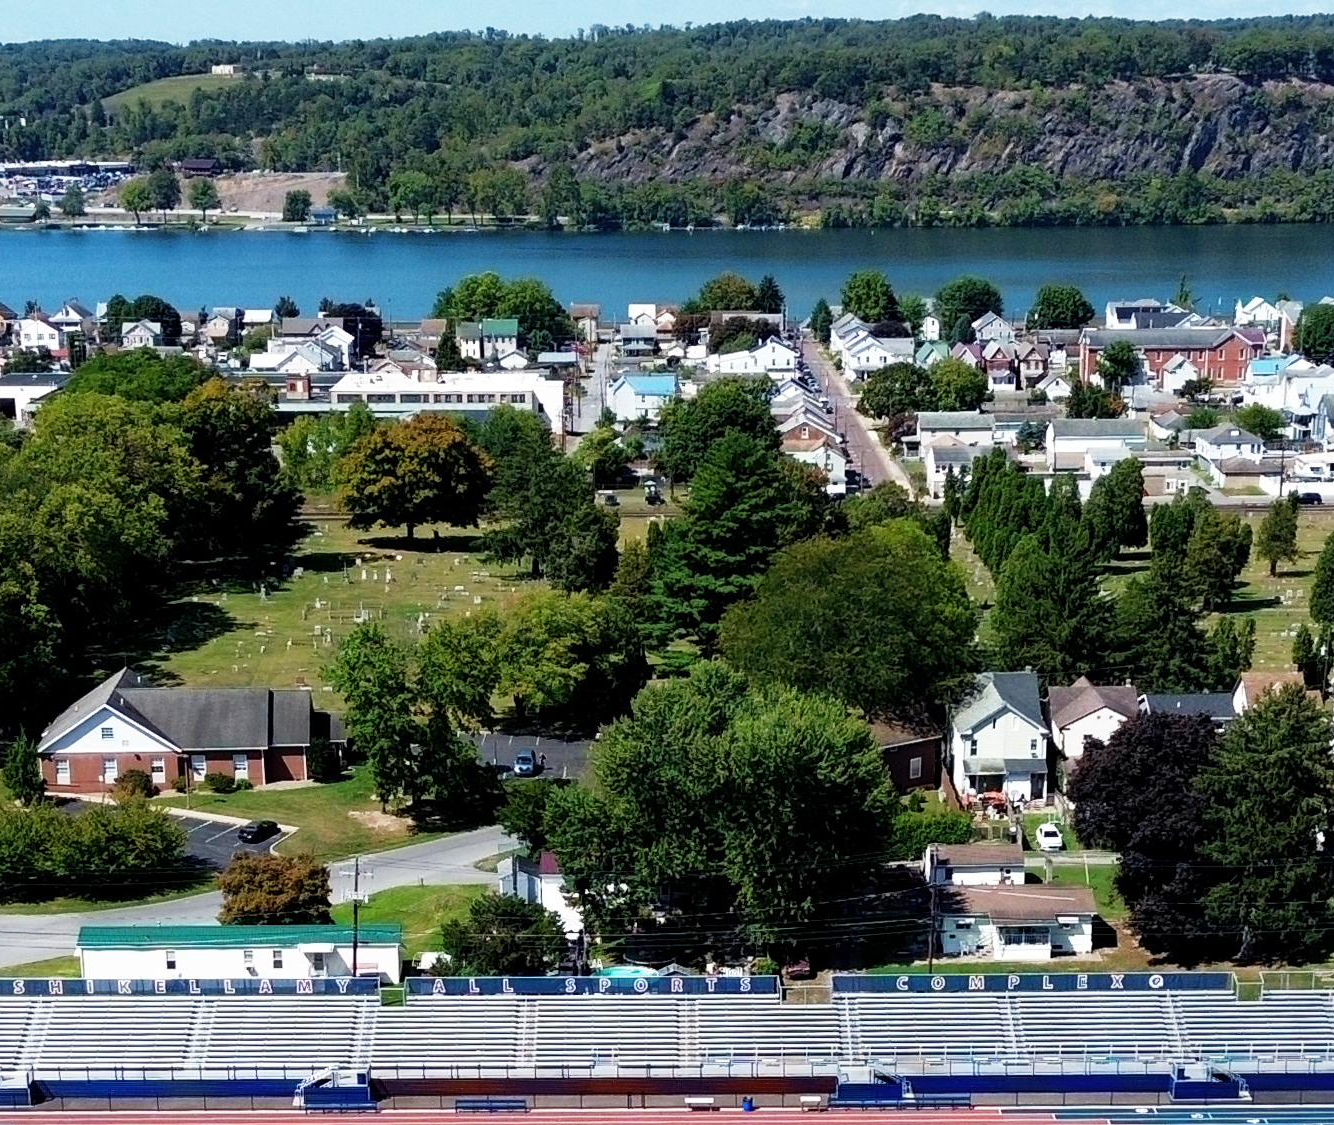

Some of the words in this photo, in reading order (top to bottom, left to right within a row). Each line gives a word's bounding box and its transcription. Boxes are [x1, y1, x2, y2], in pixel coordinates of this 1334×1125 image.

[13, 979, 351, 995] SHIKELLAMY
[433, 978, 515, 994] ALL
[566, 977, 752, 993] SPORTS
[896, 975, 1124, 991] COMPLEX
